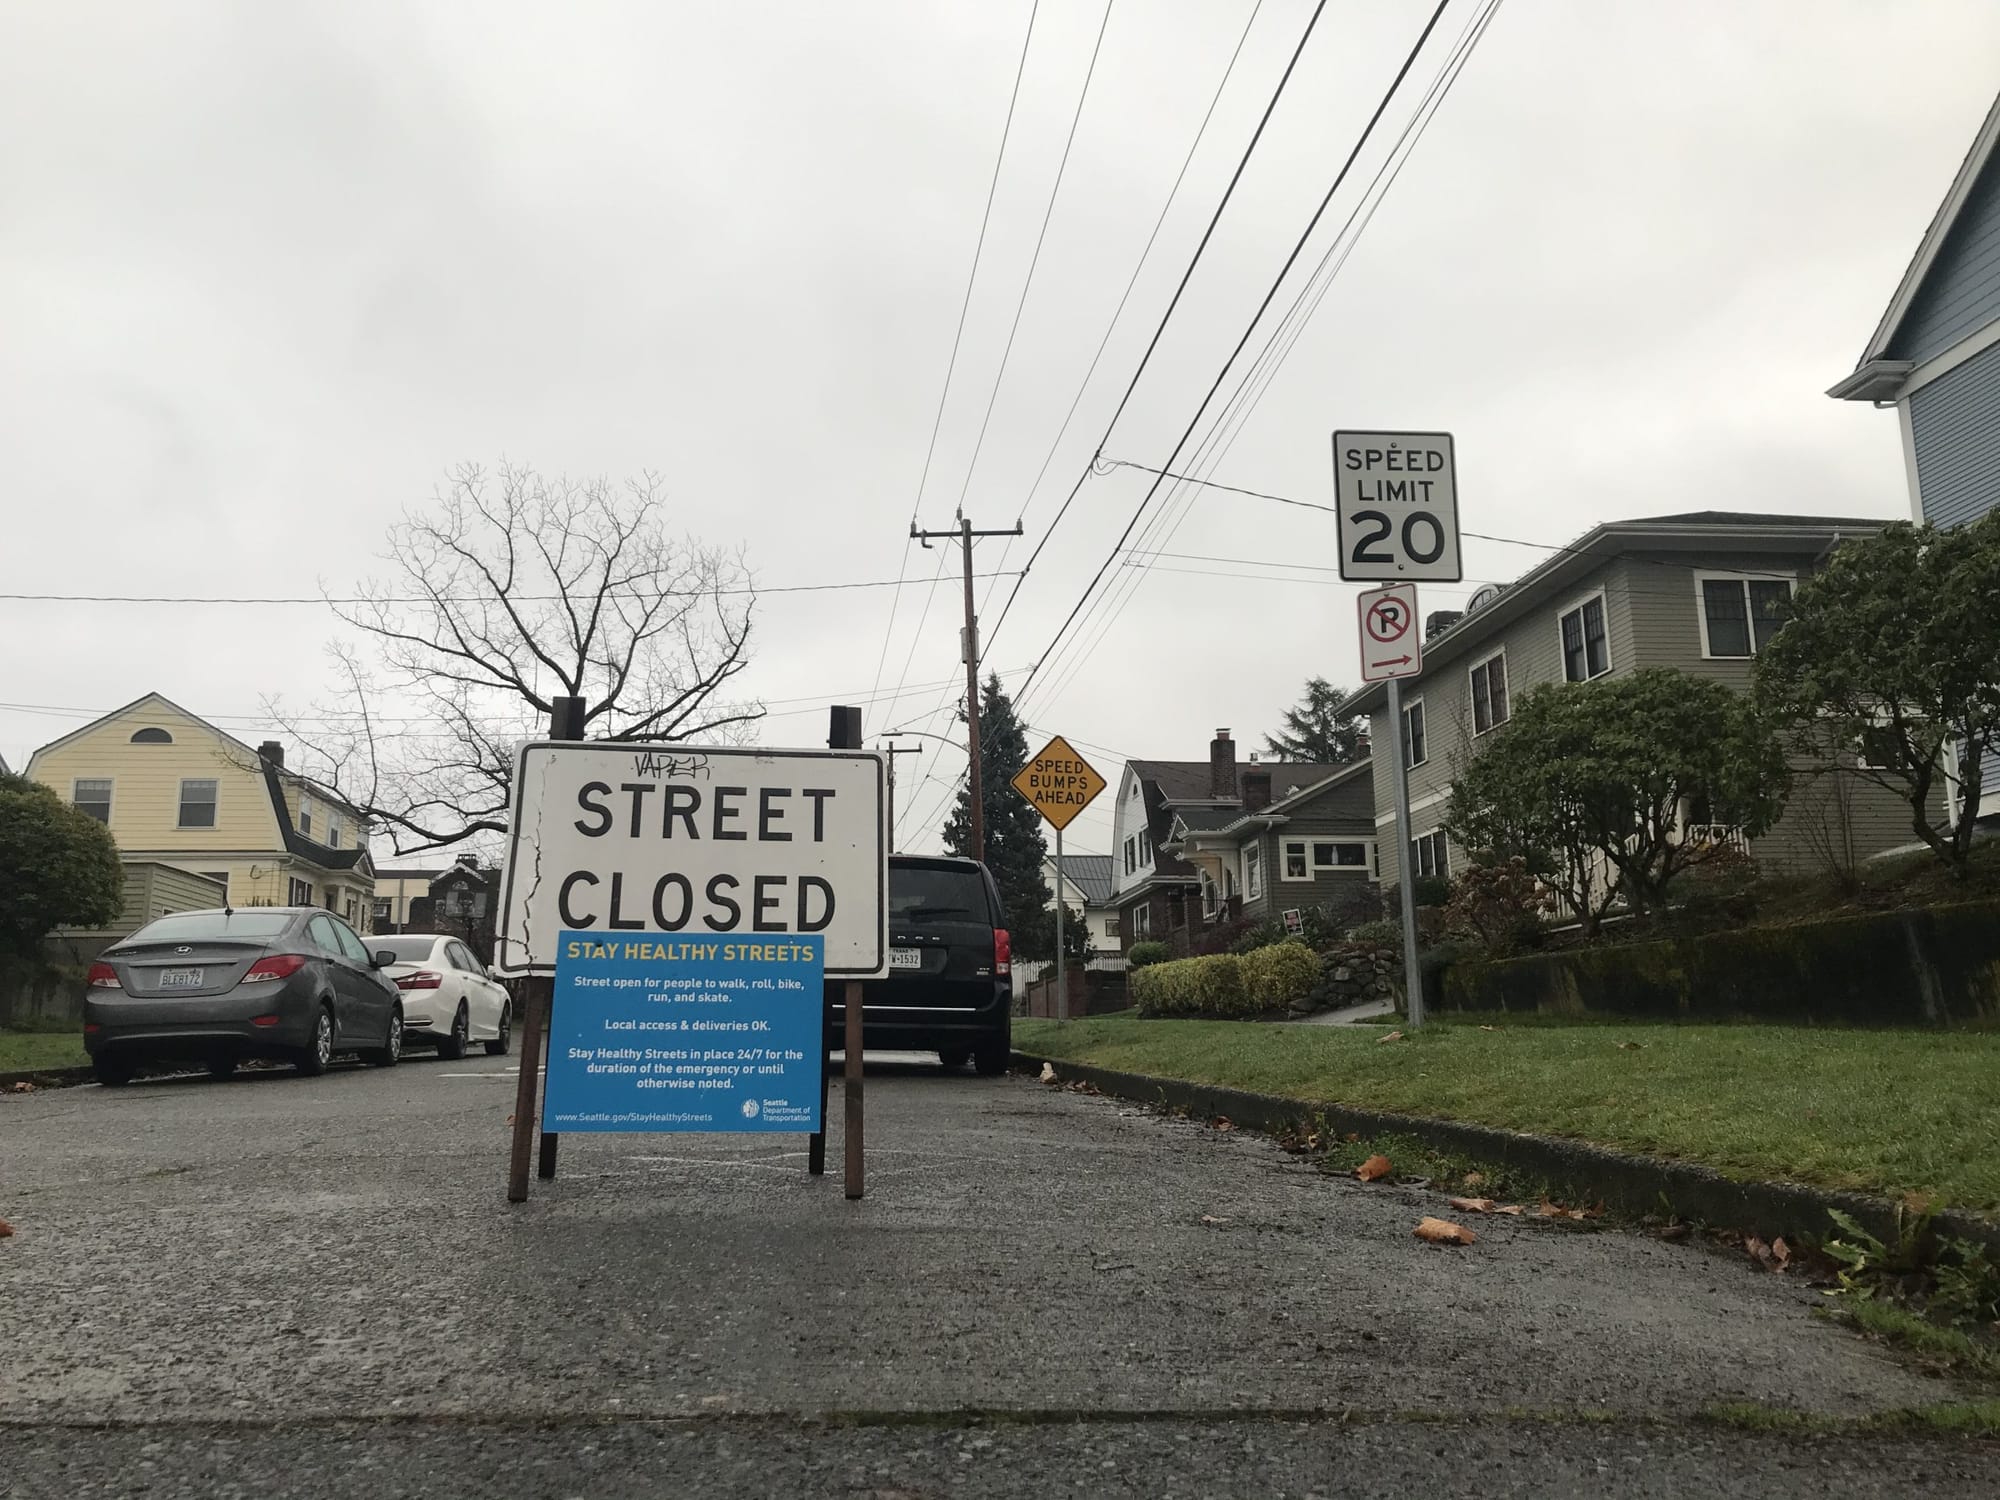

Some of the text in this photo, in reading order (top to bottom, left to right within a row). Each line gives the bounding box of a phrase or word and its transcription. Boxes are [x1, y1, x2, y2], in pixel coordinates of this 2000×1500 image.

[1345, 448, 1444, 472] SPEED
[1357, 479, 1434, 502] LIMIT
[1350, 509, 1445, 565] 20
[1035, 759, 1084, 774] SPEED
[1030, 774, 1088, 789] BUMPS
[1034, 790, 1085, 805] AHEAD
[573, 781, 836, 843] STREET
[558, 870, 836, 932] CLOSED
[567, 942, 815, 962] STAY HEALTHY STREETS
[574, 976, 805, 991] Street open for people to walk, roll, bike,
[647, 992, 732, 1003] run, and skate.
[605, 1019, 771, 1031] Local access & deliveries OK.
[568, 1048, 804, 1061] Stay Healthy Streets in place 24/7 for the
[587, 1062, 784, 1076] duration of the emergency or until
[636, 1078, 734, 1089] otherwise noted.
[555, 1112, 713, 1123] www.Seattle.gov/StayHealthyStreets
[763, 1106, 811, 1114] Department of
[763, 1114, 811, 1122] Transportation
